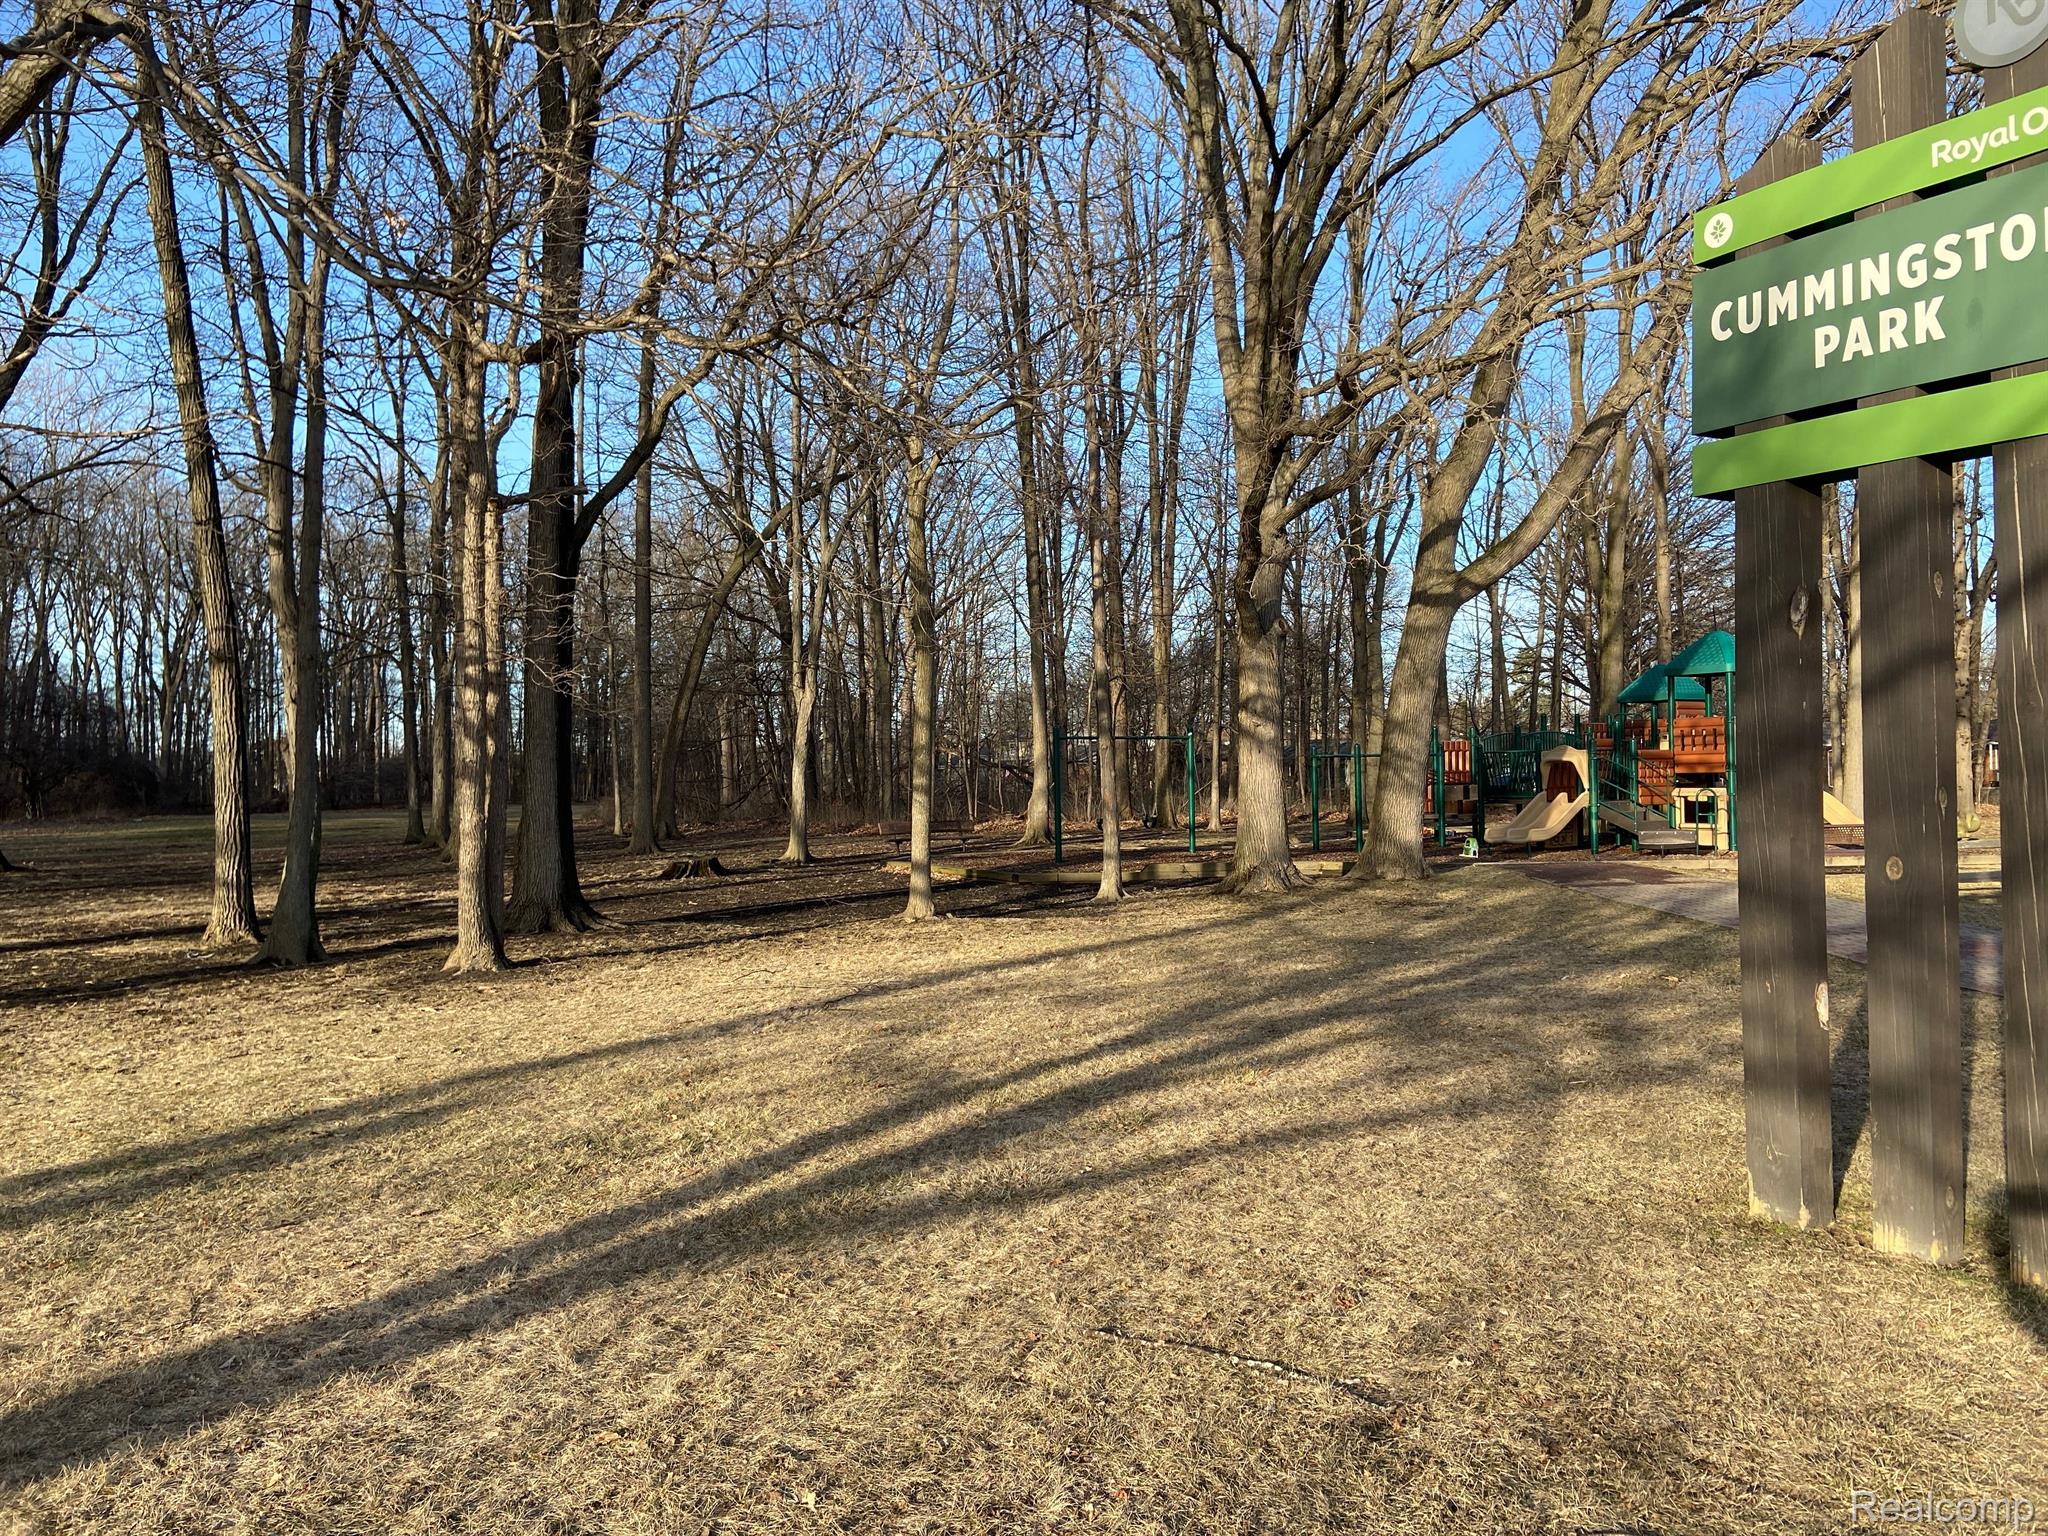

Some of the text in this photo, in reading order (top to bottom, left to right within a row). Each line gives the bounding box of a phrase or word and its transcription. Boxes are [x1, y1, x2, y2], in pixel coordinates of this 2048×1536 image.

[1931, 114, 2019, 168] Royal
[1710, 206, 2048, 341] CUMMINGSTO
[1814, 295, 1946, 369] PARK
